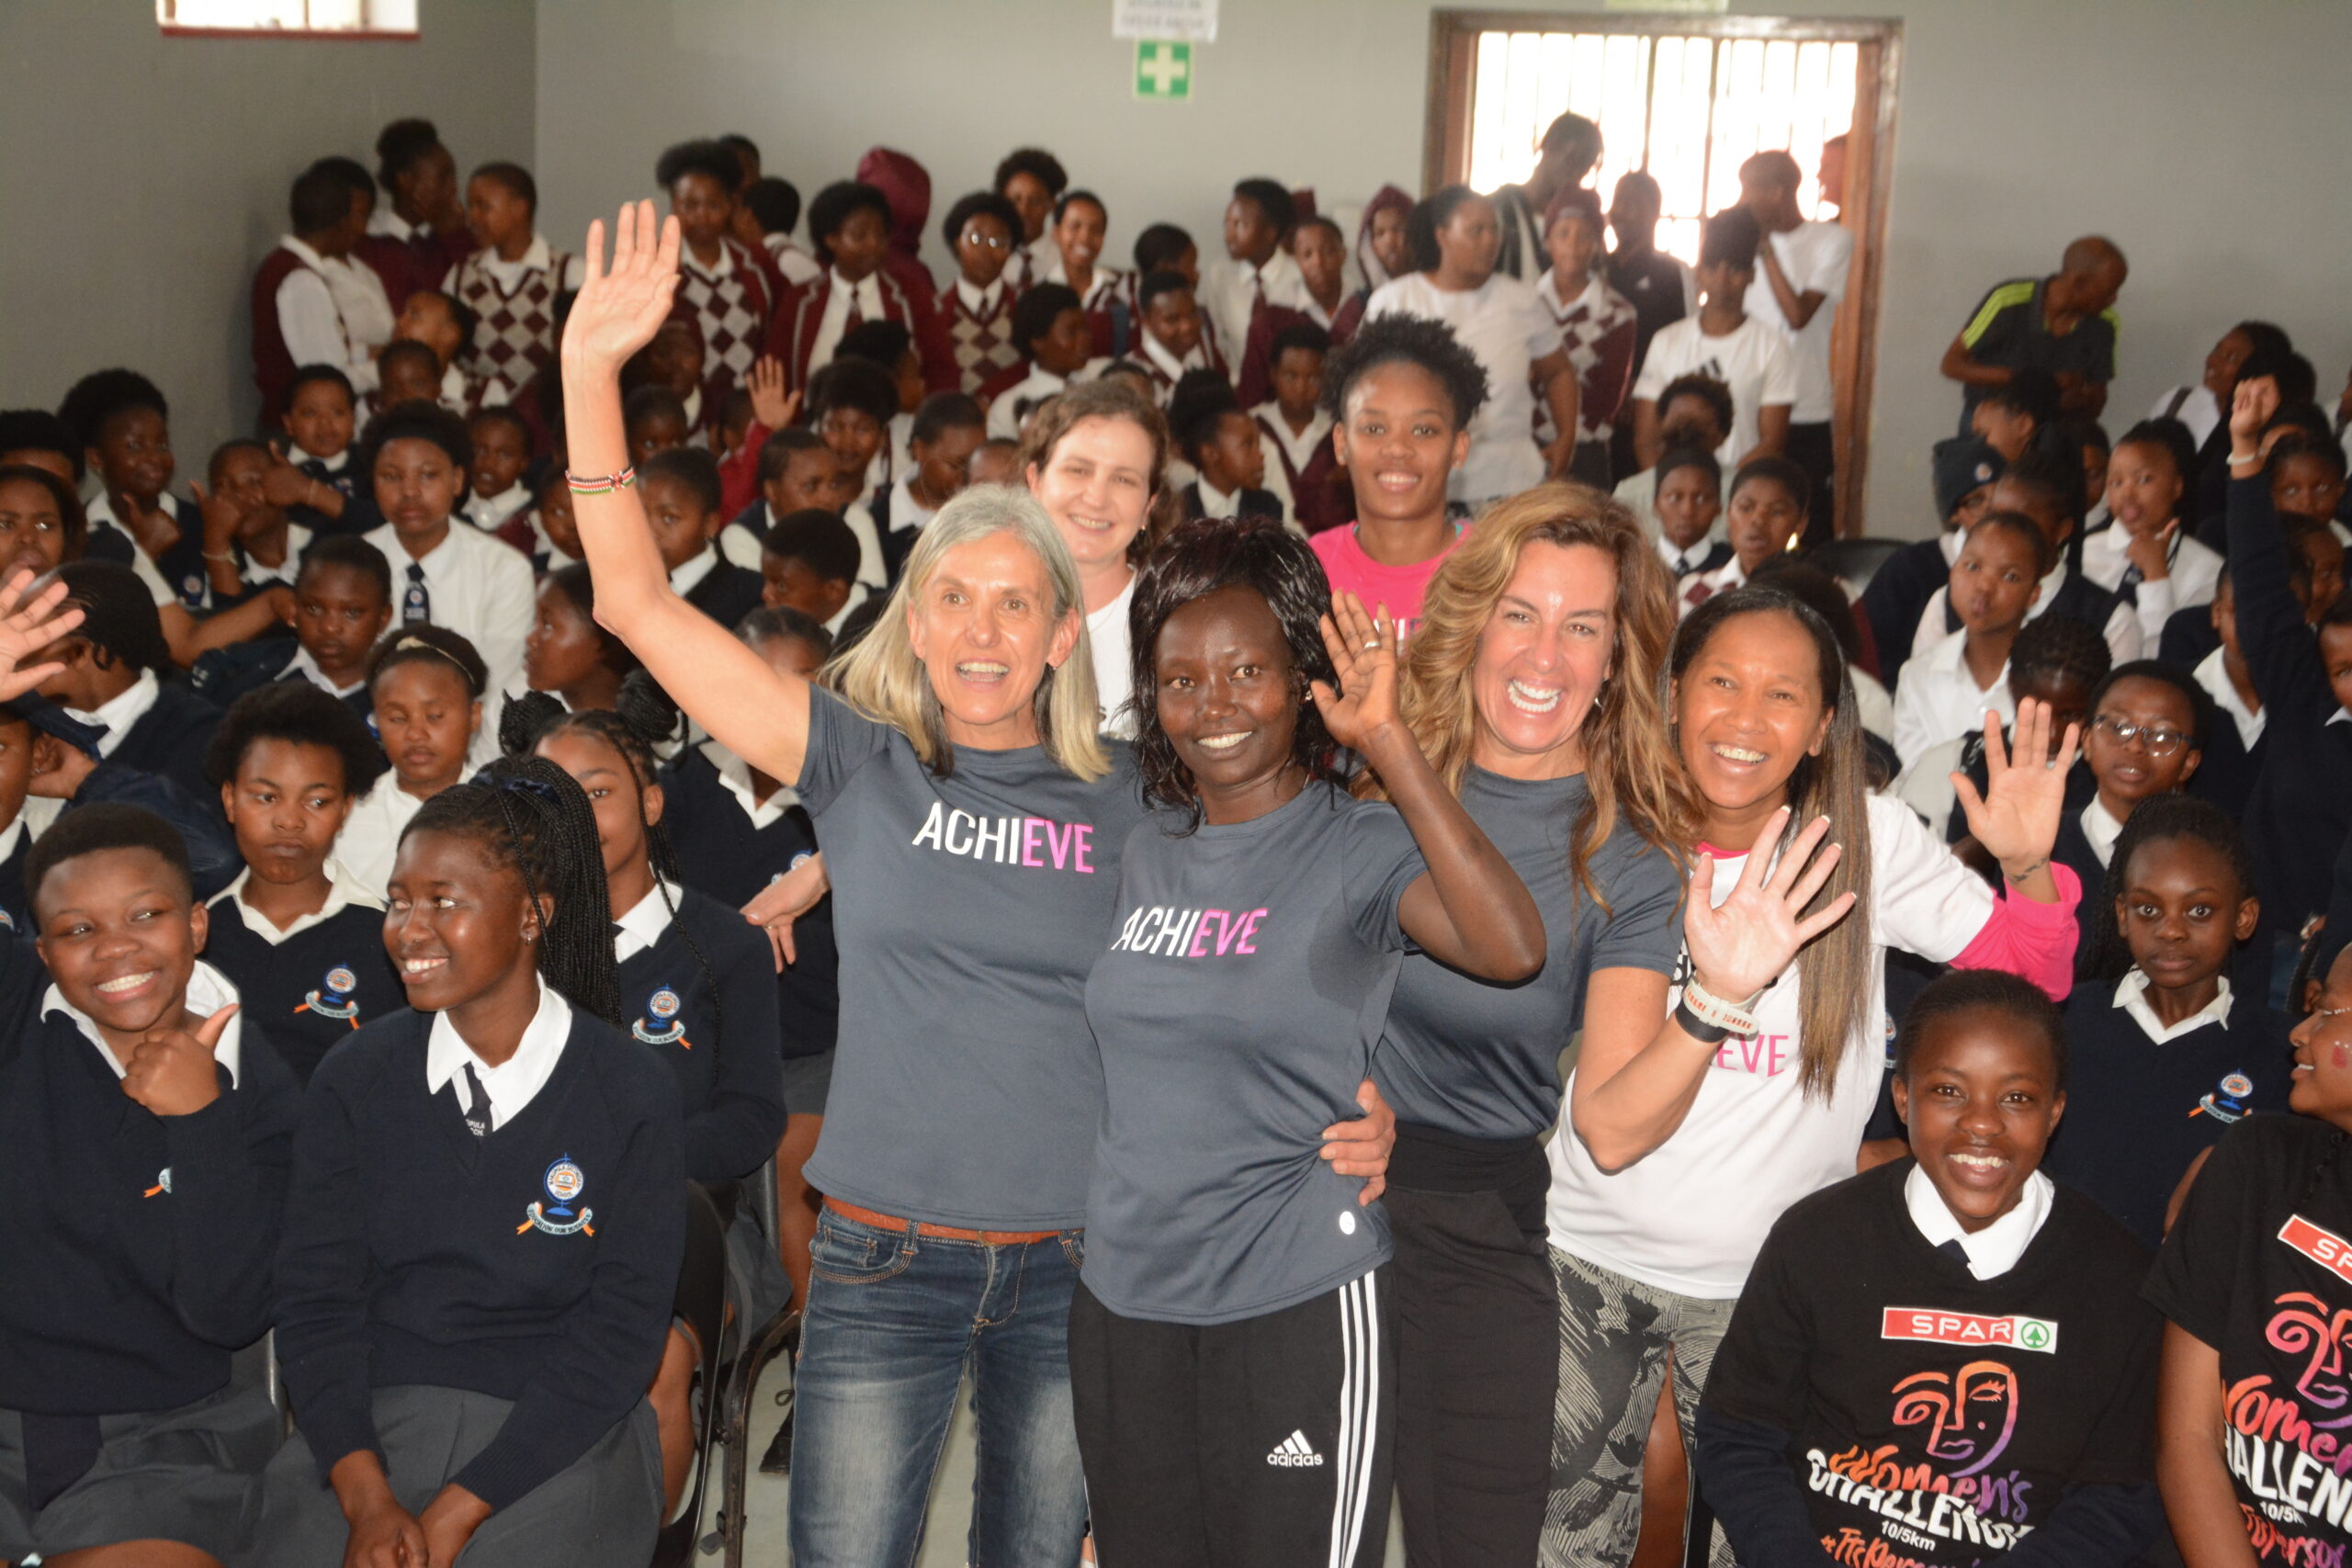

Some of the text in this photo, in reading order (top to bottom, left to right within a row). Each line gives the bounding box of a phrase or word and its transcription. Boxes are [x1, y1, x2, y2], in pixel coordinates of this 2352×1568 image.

[911, 800, 1094, 874] ACHIEVE
[1111, 905, 1270, 958] ACHIEVE
[1911, 1314, 2012, 1340] SPAR
[1267, 1452, 1324, 1467] adidas
[1829, 1444, 2032, 1523] Women's
[1806, 1449, 2036, 1551] CHALLENG
[1881, 1520, 1936, 1552] 10/5km
